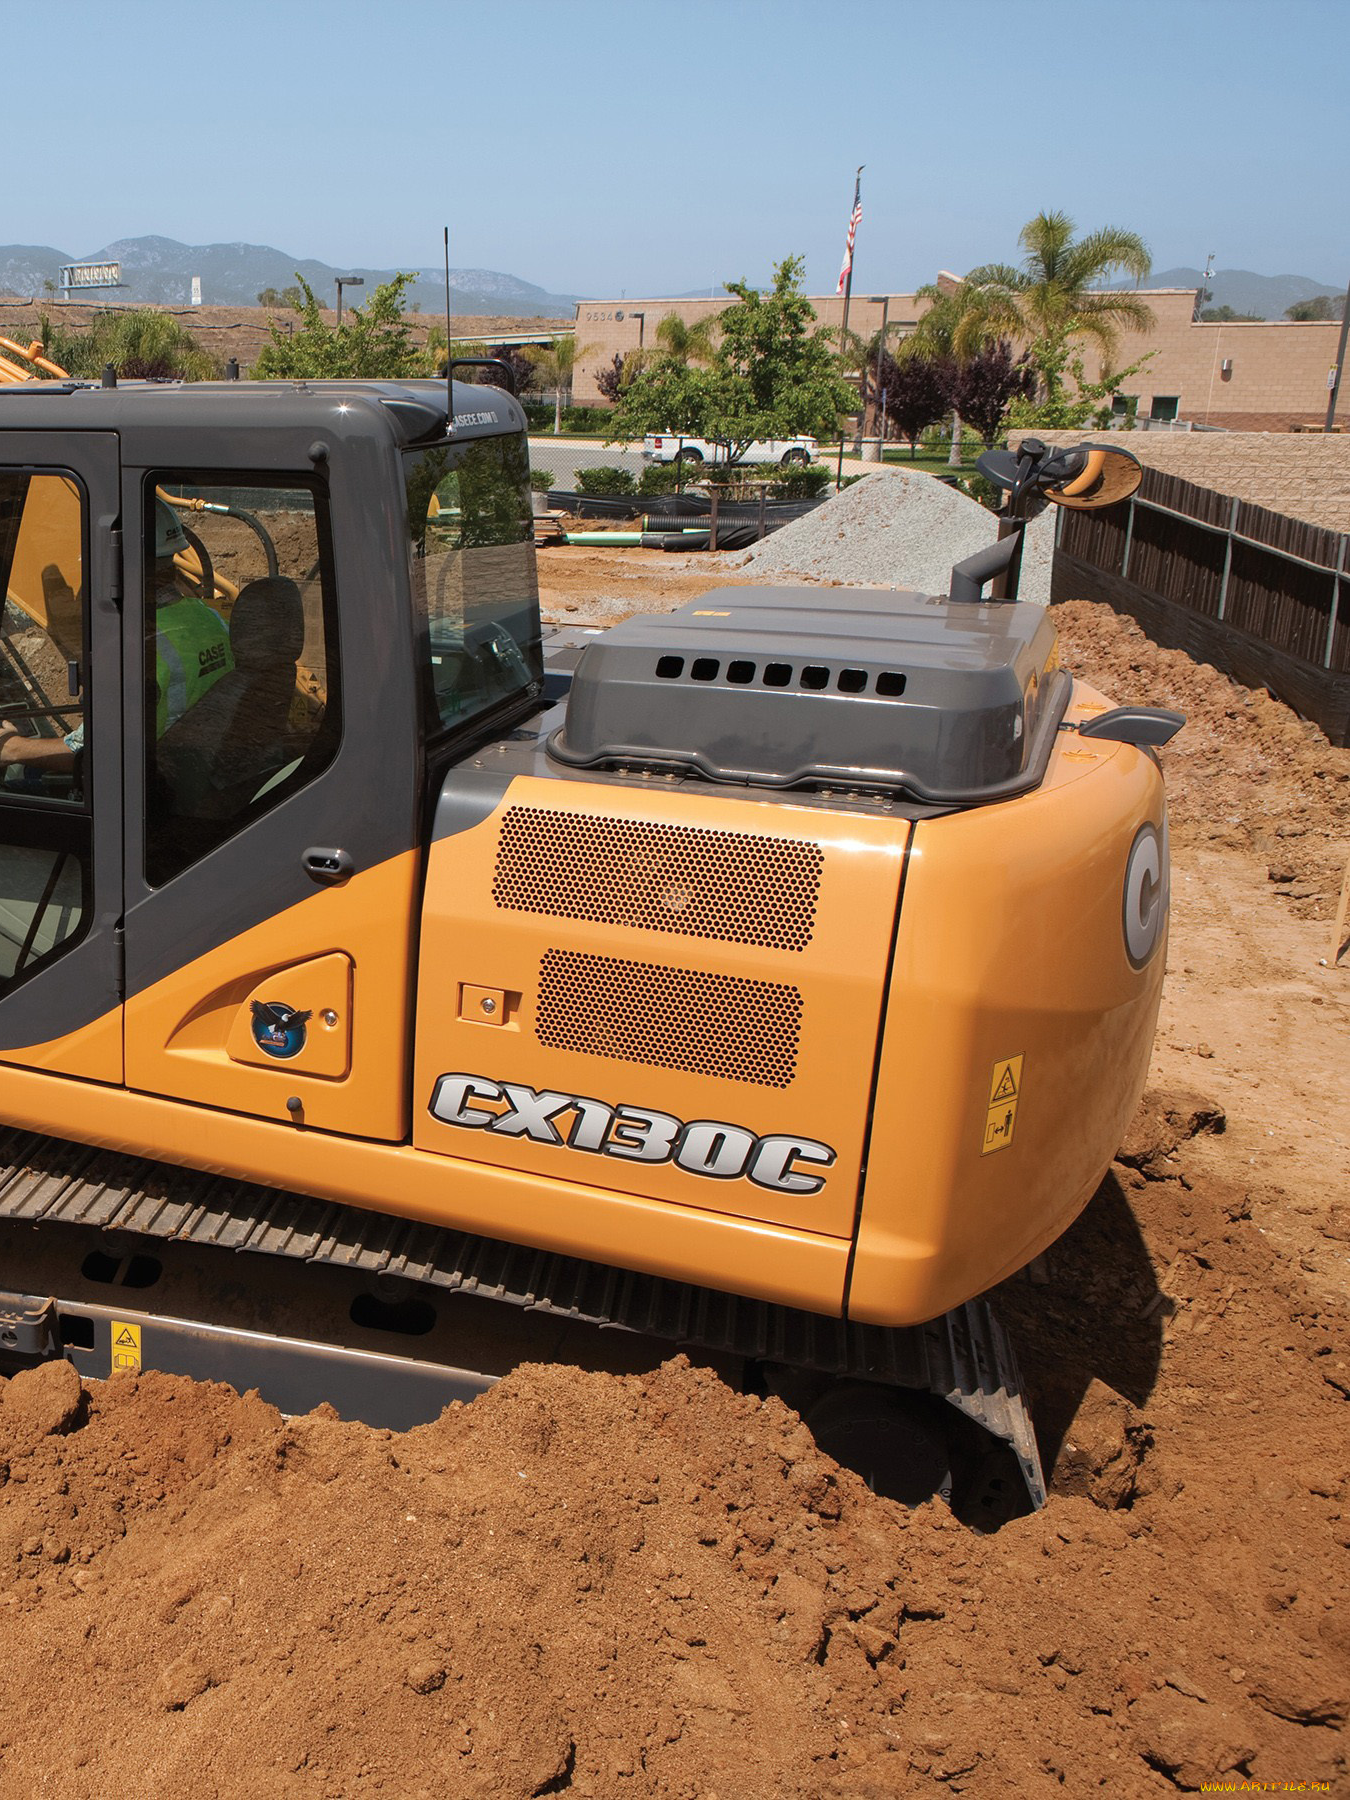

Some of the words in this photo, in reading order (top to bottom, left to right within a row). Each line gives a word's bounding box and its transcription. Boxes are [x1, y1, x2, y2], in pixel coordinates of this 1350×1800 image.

[452, 411, 493, 428] ASECE.COM
[198, 643, 226, 666] CASE
[428, 1072, 838, 1195] CX130C
